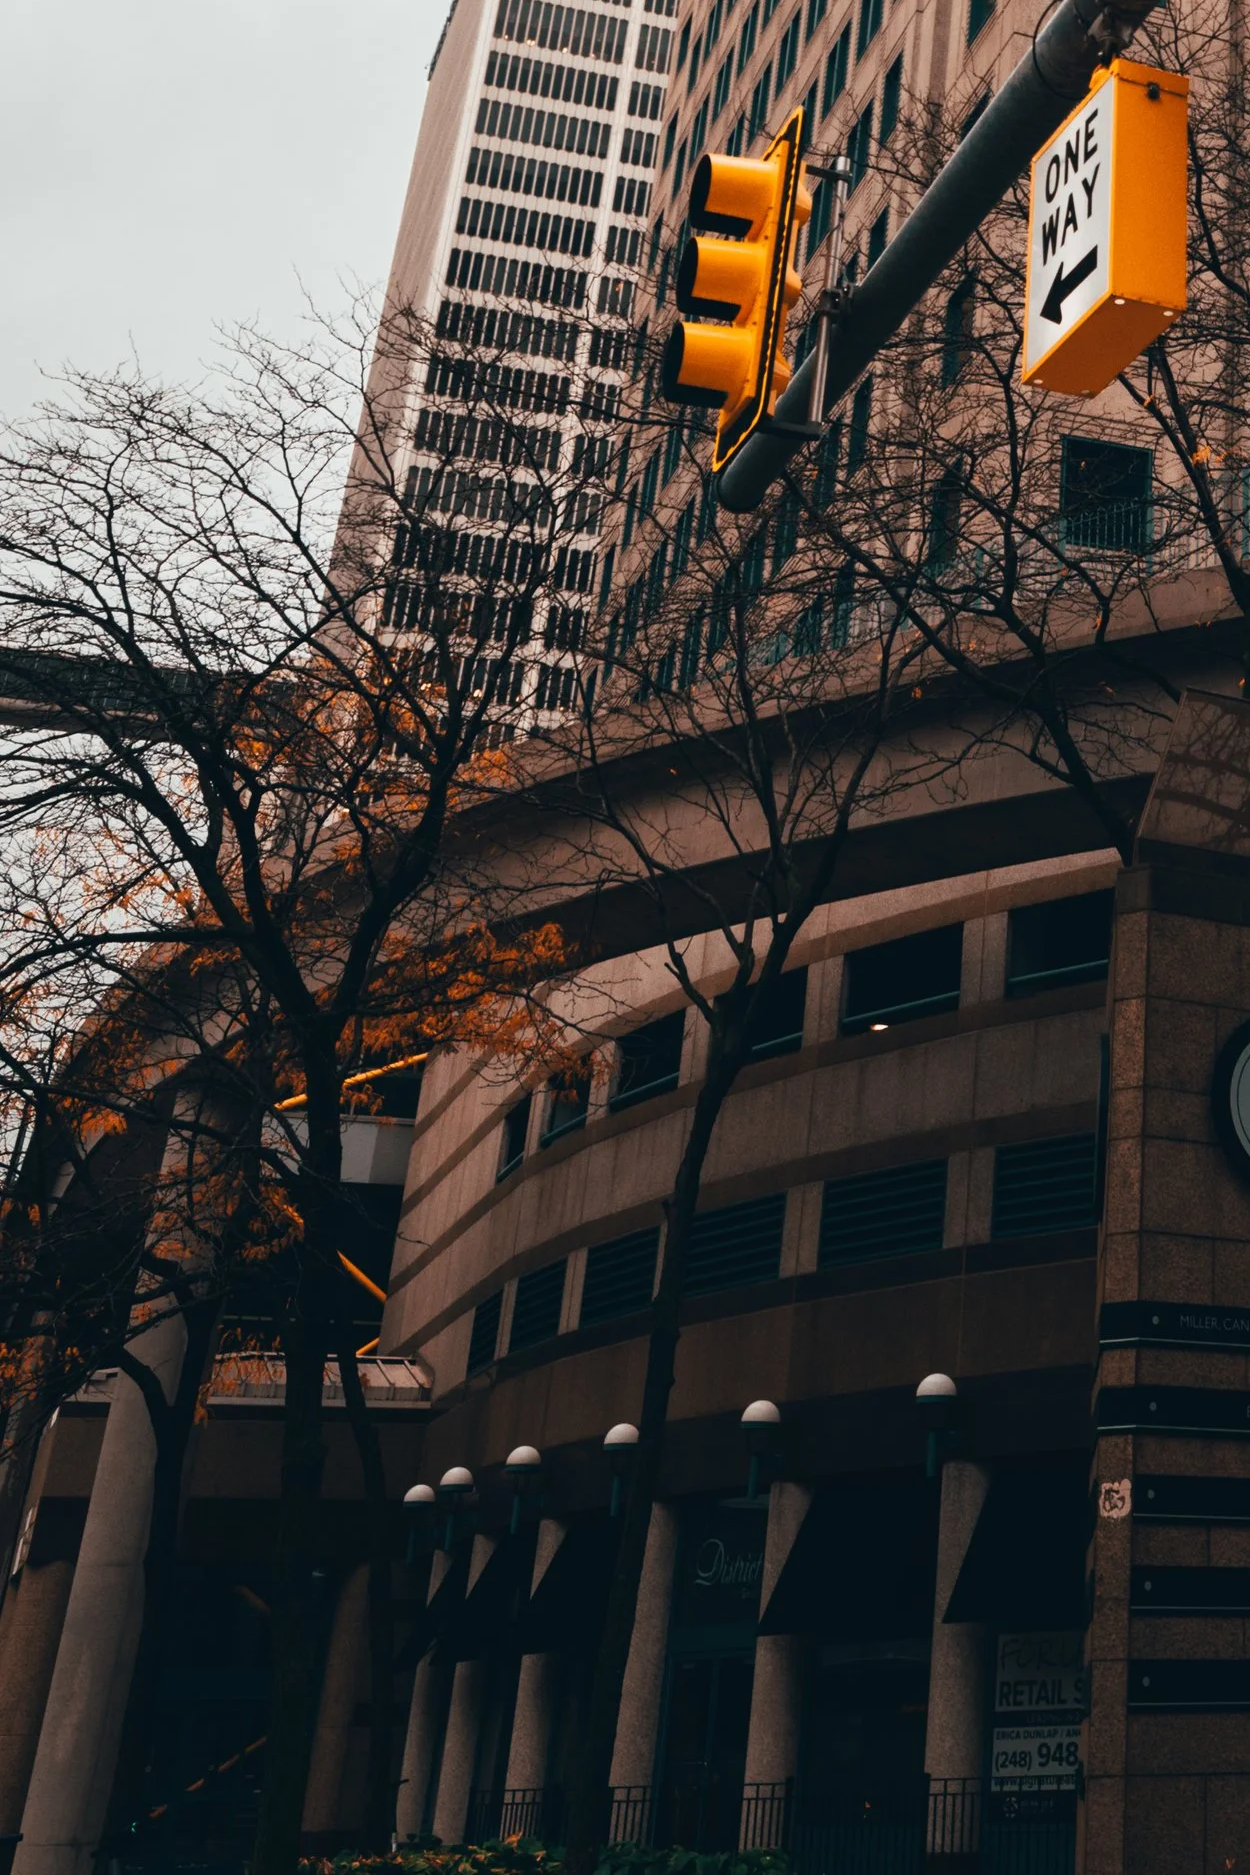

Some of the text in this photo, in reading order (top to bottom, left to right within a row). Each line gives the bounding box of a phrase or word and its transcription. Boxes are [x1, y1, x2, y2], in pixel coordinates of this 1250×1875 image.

[1045, 108, 1098, 204] ONE
[1042, 162, 1101, 267] WAY
[999, 1679, 1067, 1707] RETAIL
[996, 1729, 1021, 1740] ERICA
[1023, 1729, 1058, 1739] DUNLAP
[995, 1750, 1033, 1772] (248)
